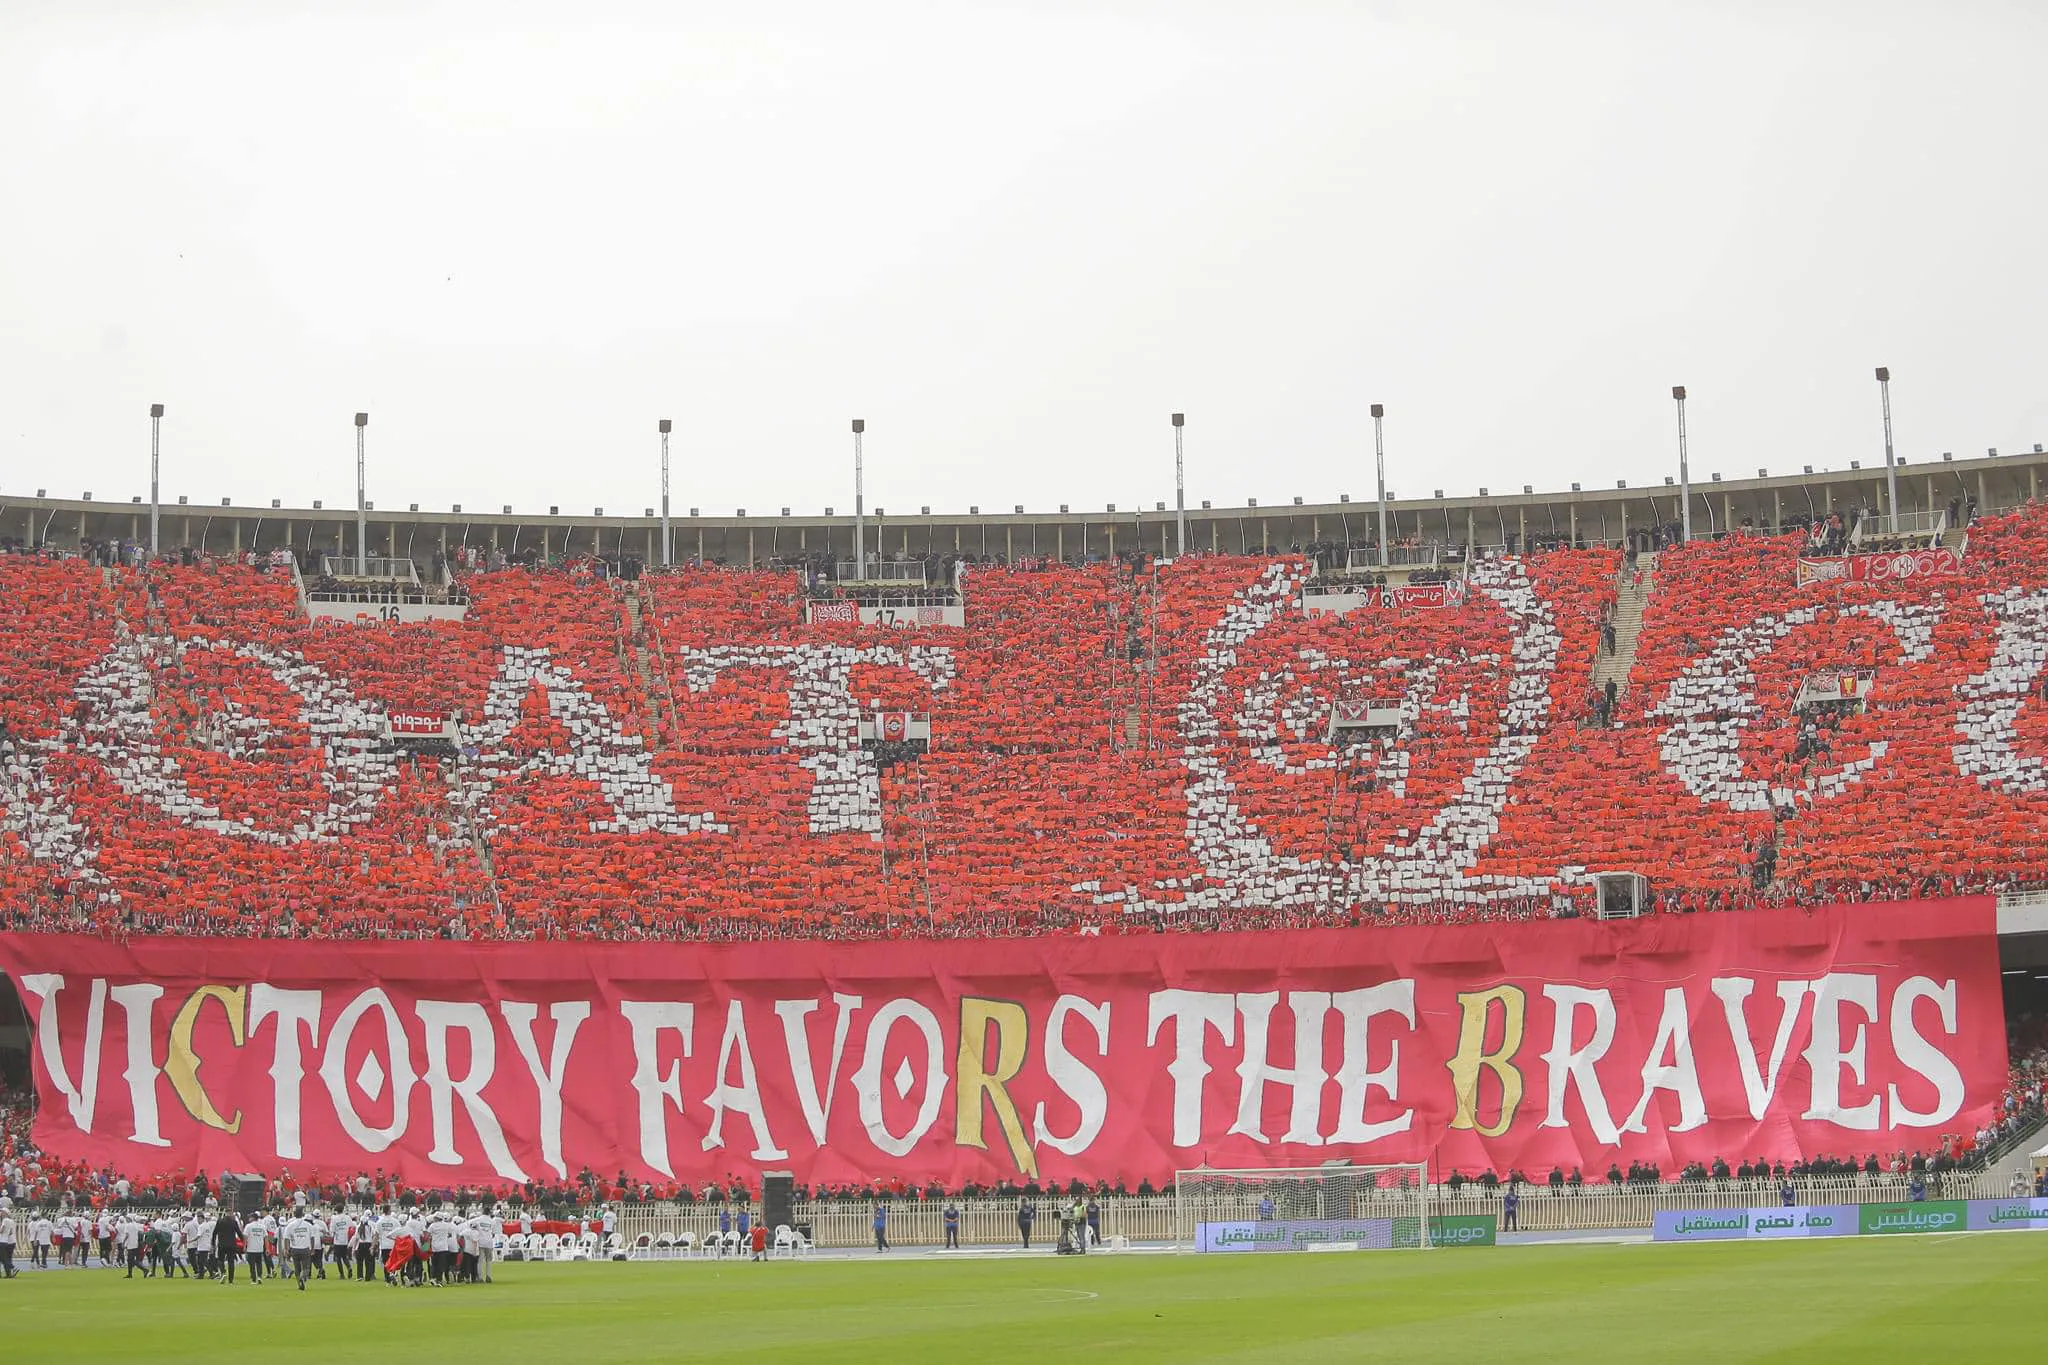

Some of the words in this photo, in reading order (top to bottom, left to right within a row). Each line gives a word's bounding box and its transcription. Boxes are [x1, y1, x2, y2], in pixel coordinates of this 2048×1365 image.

[380, 606, 400, 625] 16
[876, 610, 896, 629] 17
[20, 972, 591, 1184] VICTORY
[620, 991, 1112, 1181] FAVORS
[1146, 977, 1417, 1149] THE
[1446, 971, 1966, 1148] BRAVES
[1674, 1214, 1749, 1234] المستقبل
[1755, 1213, 1795, 1233] نصنع
[1868, 1209, 1957, 1230] موبيليس
[1215, 1226, 1286, 1246] المستقبل
